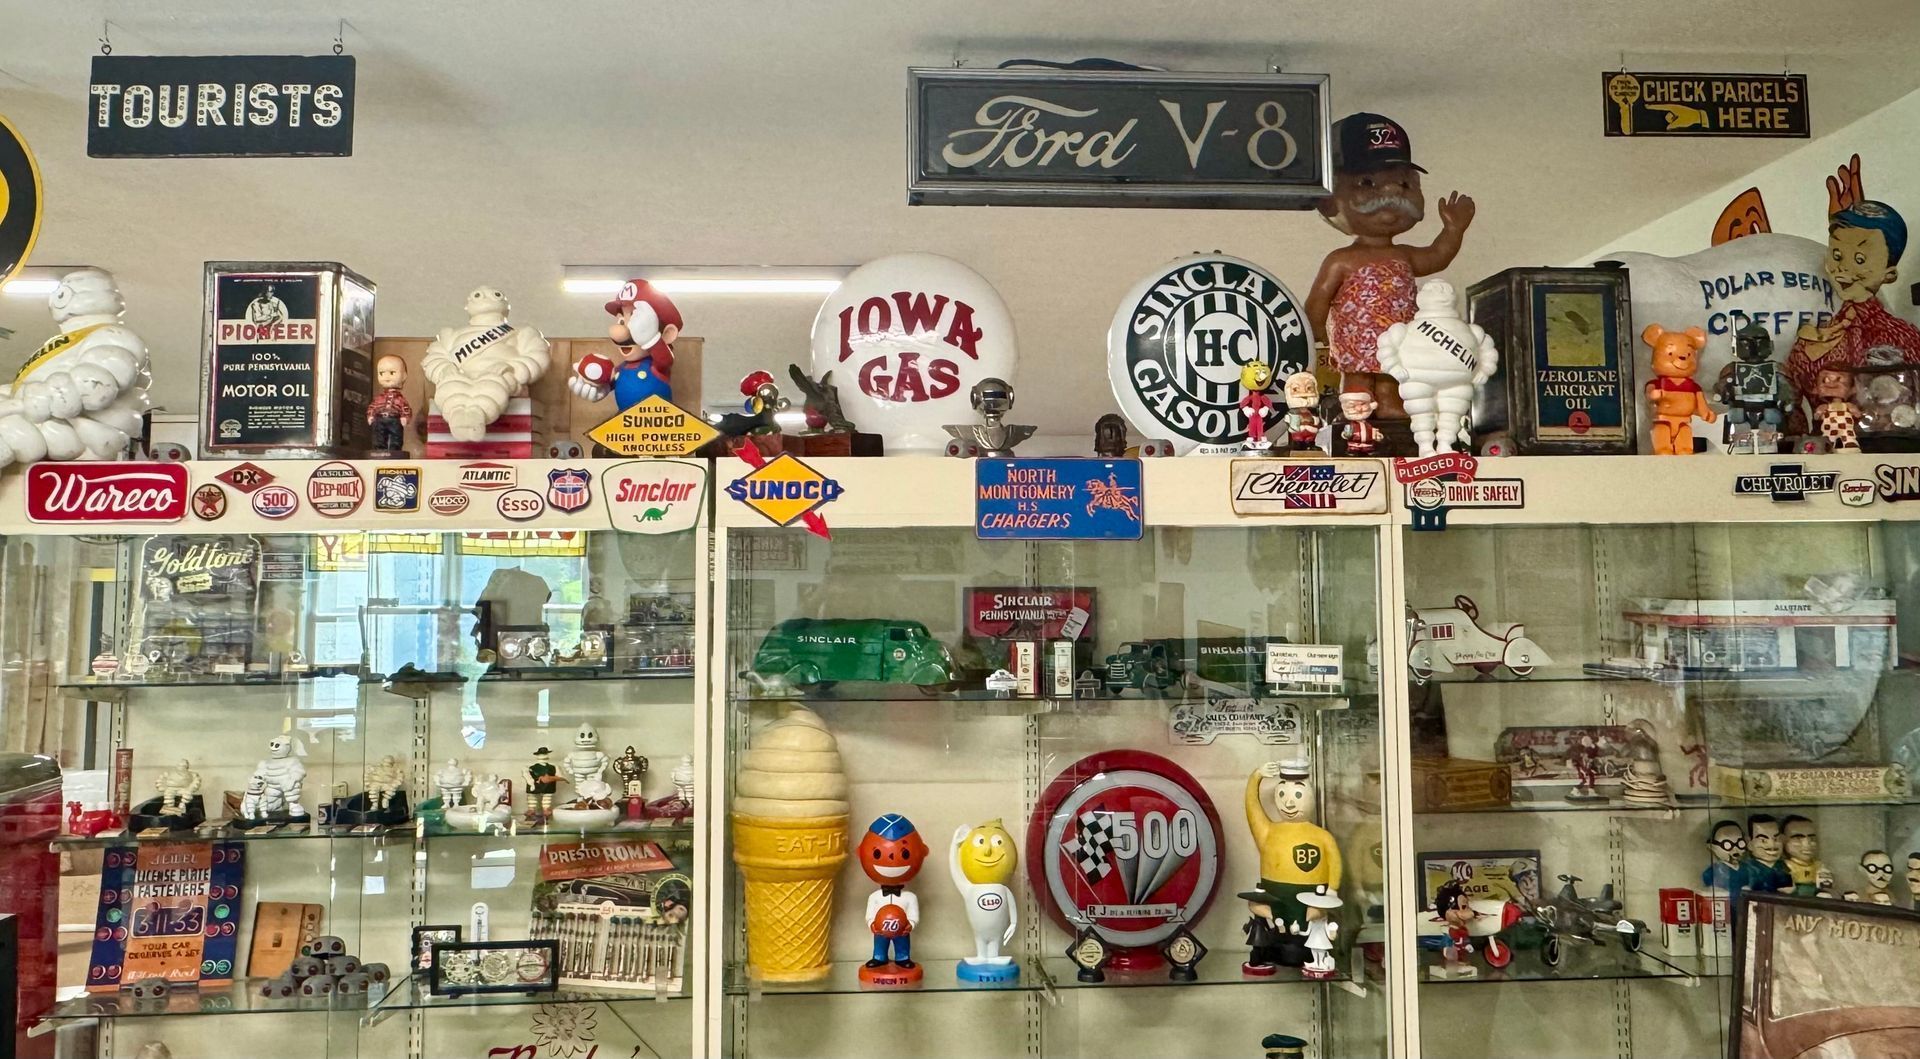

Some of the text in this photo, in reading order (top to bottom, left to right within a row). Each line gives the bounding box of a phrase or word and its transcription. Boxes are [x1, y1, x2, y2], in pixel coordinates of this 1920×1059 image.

[1643, 80, 1706, 103] CHECK
[1711, 81, 1800, 104] PARCELS
[90, 82, 344, 128] TOURISTS
[1718, 107, 1790, 129] HERE
[941, 95, 1139, 169] Ford
[1370, 128, 1393, 145] 32
[1700, 271, 1835, 312] POLAR BEAR
[1134, 262, 1302, 343] SINCLAIR
[222, 323, 314, 341] PIONEER
[838, 291, 983, 362] IOWA
[454, 323, 514, 364] MICHELIN
[1417, 321, 1477, 372] MICHELIN
[251, 352, 281, 361] 100%
[223, 362, 311, 371] PURE PENNSYLVANIA
[858, 352, 961, 403] GAS
[1537, 370, 1618, 382] ZEROLENE
[222, 384, 310, 398] MOTOR OIL
[1543, 384, 1615, 397] AIRCRAFT
[1565, 398, 1591, 410] OIL
[623, 414, 685, 428] SUNOCO
[606, 433, 701, 442] HIGH POWERED
[623, 443, 685, 452] KNOCKLESS
[1398, 457, 1474, 478] PLEDGED TO
[462, 471, 511, 481] ATLANTIC
[1007, 469, 1056, 483] NORTH
[1740, 475, 1832, 493] CHEVROLET
[39, 472, 178, 512] Wareco
[312, 479, 360, 500] DEEP-ROCK
[615, 478, 697, 503] Sinclair
[729, 478, 840, 501] SUNOCO
[980, 484, 1076, 499] MONTGOMERY
[1250, 473, 1366, 503] Chevrolet
[1448, 485, 1519, 501] DRIVE SAFELY
[262, 493, 288, 507] 500
[430, 496, 466, 507] AMOCO
[981, 512, 1073, 528] CHARGERS
[993, 594, 1053, 609] SINCLAIR
[979, 609, 1045, 621] PENNSYLVANIA
[797, 635, 857, 645] SINCLAIR
[1801, 769, 1880, 780] GUARANTEE
[1109, 809, 1198, 860] 500
[549, 844, 656, 865] PRESTO ROMA
[1296, 849, 1318, 864] BP
[137, 867, 209, 882] LICENSE PLATE
[138, 882, 204, 897] FASTENERS
[1088, 905, 1096, 916] R
[1100, 905, 1106, 916] J
[882, 918, 900, 931] 76
[1785, 914, 1905, 946] ANY MOTOR
